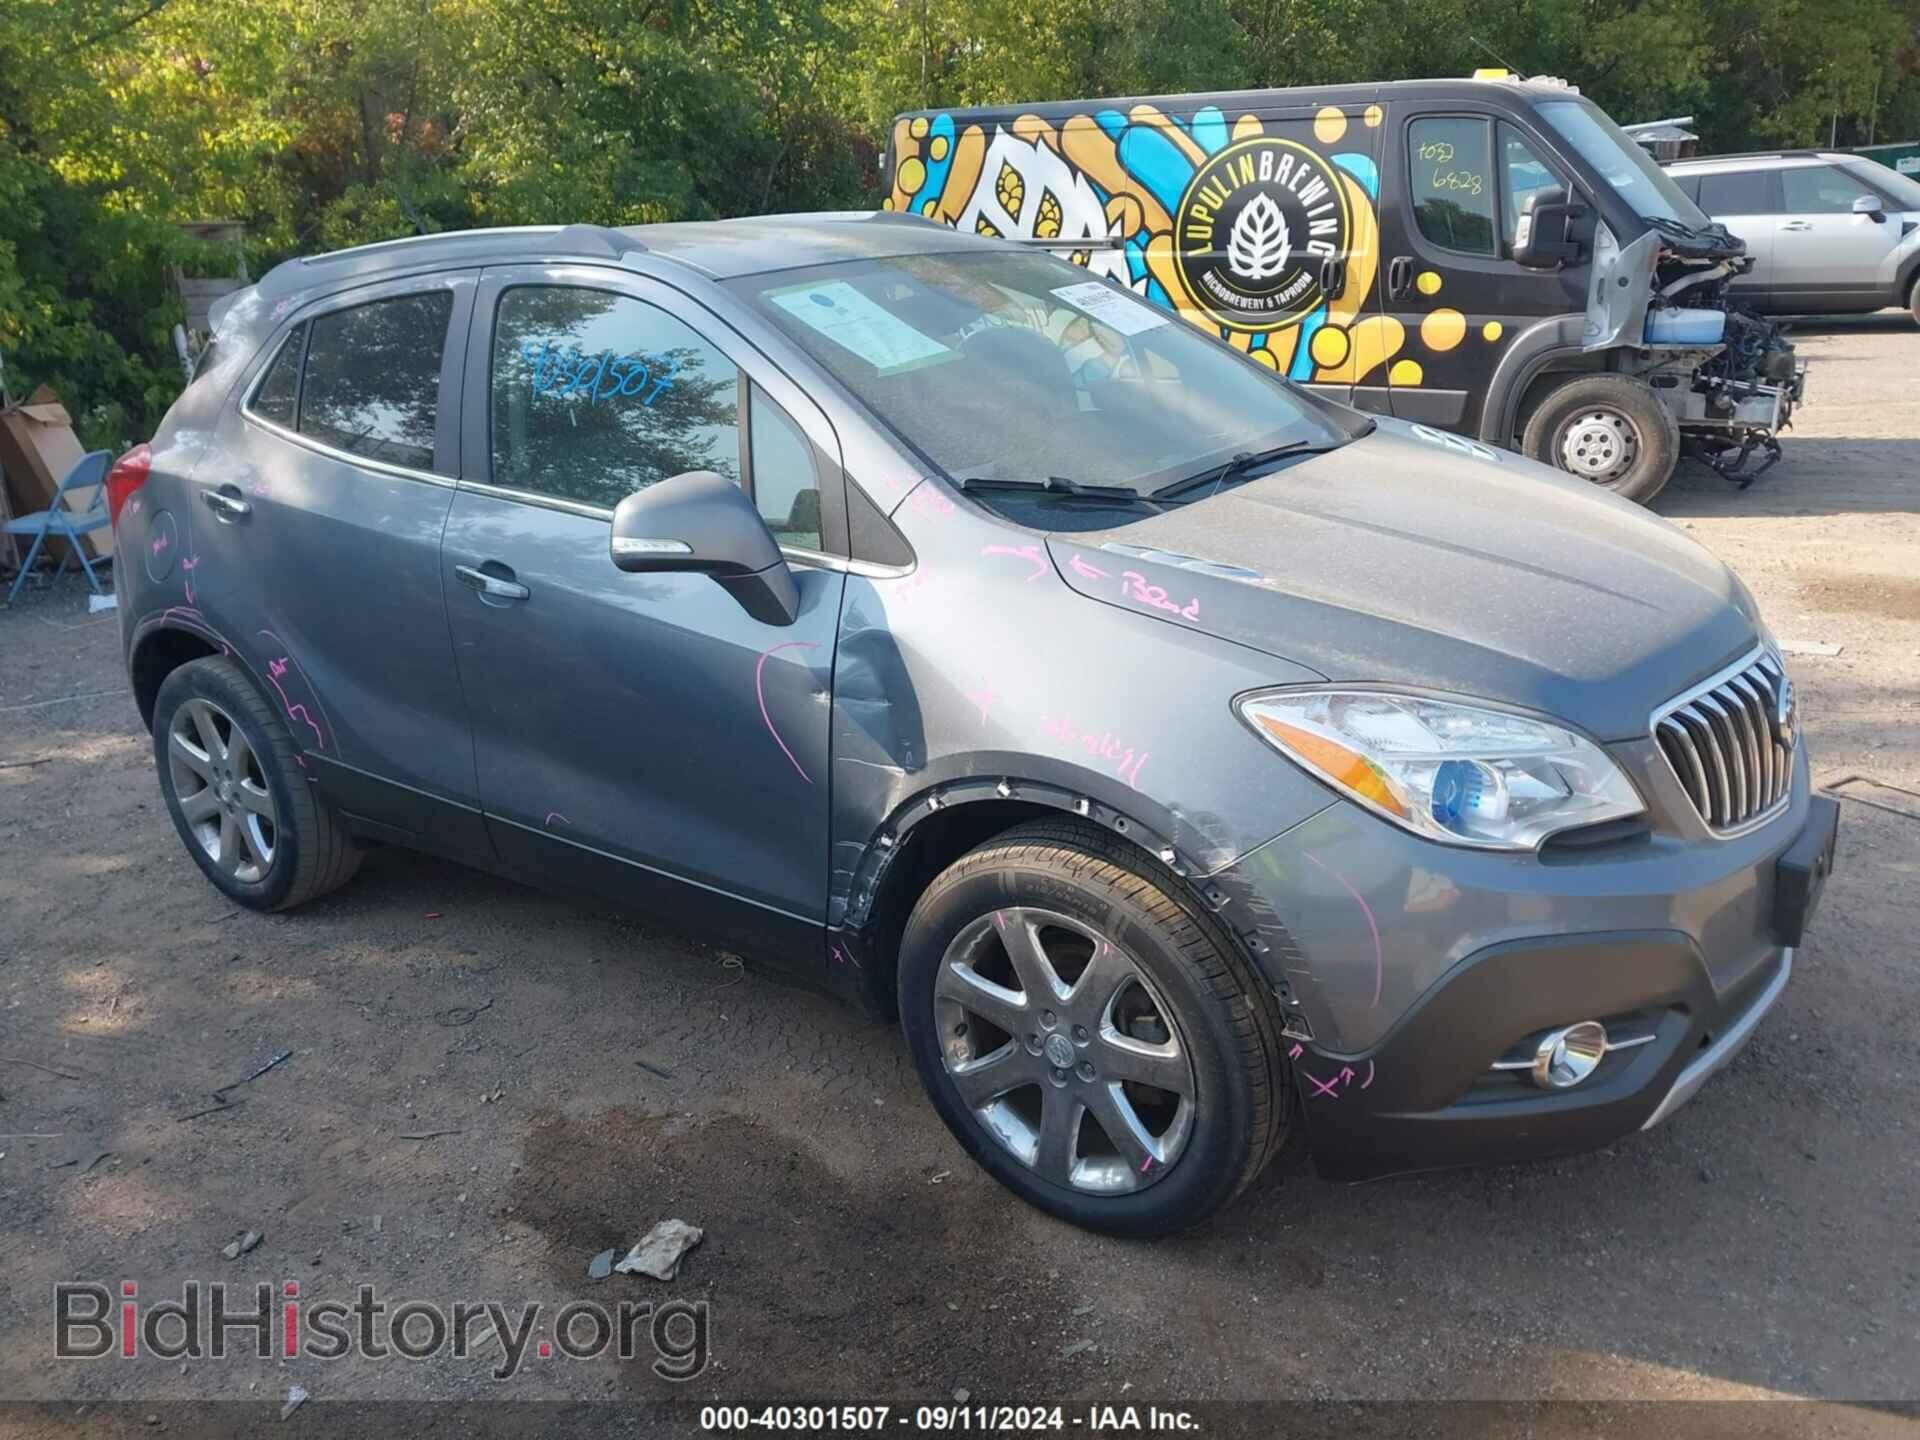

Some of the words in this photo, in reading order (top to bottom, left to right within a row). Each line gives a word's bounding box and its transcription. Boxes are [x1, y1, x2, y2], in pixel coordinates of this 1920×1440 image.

[1432, 167, 1482, 196] 6828
[1186, 153, 1256, 257] LUPULIN
[1258, 150, 1339, 258] BREWING
[1201, 270, 1267, 310] MICROBREWERY
[1266, 297, 1274, 308] &
[1273, 271, 1315, 307] TAPROOM
